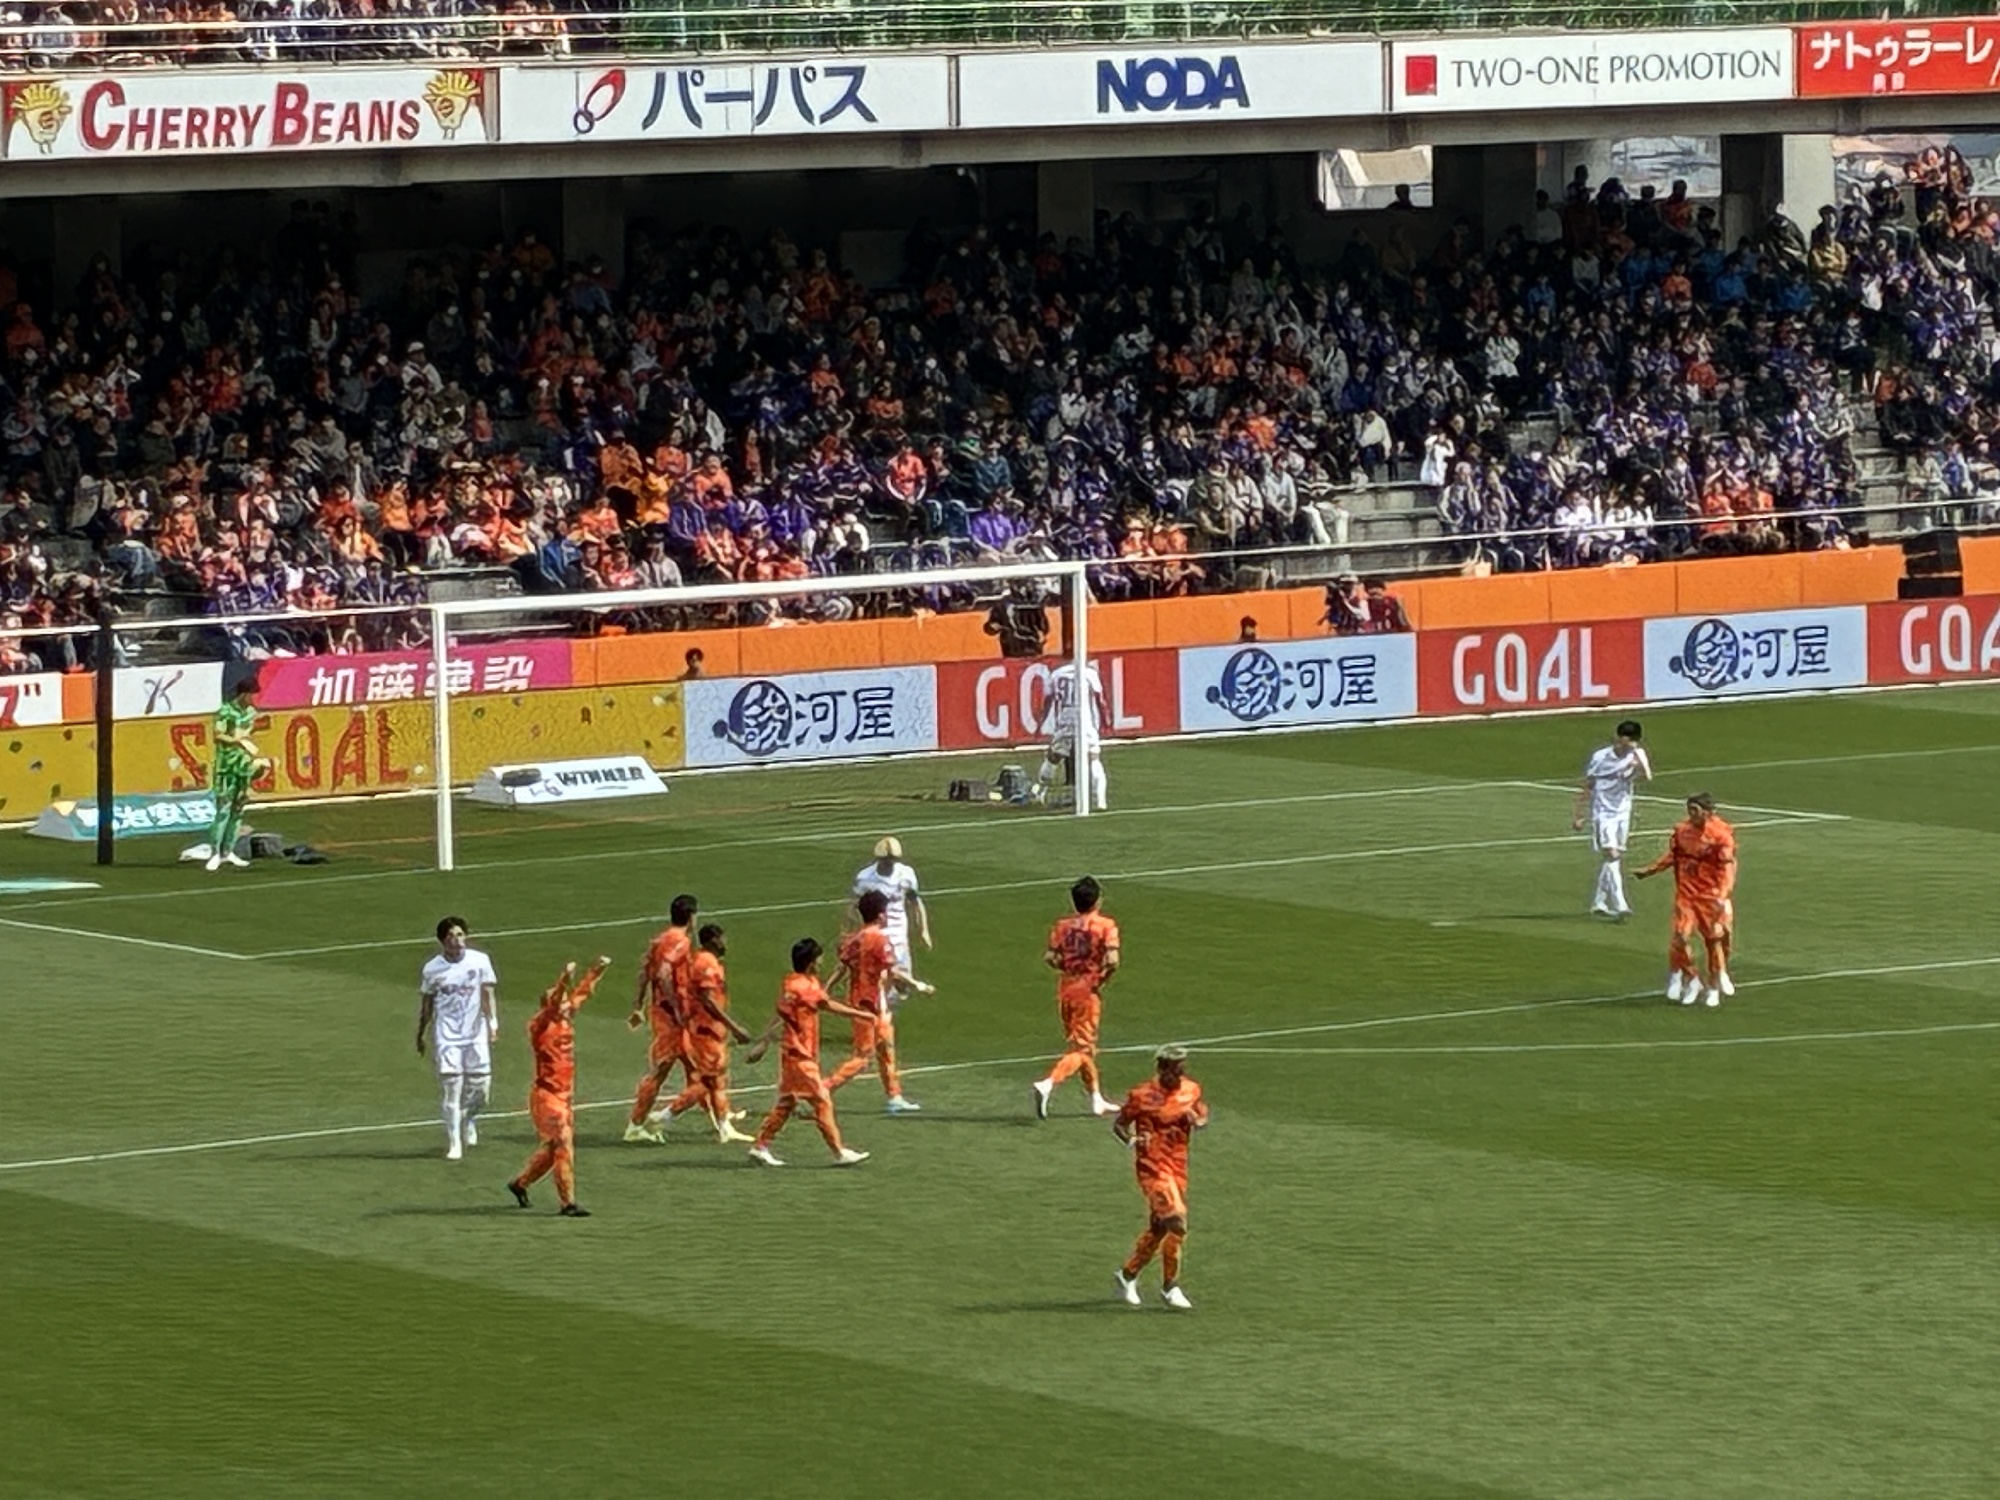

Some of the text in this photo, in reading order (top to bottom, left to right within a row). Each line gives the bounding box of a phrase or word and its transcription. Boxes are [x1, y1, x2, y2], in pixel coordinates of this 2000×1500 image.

[1451, 50, 1782, 88] TWO-ONE PROMOTION
[1810, 26, 1994, 70] ナトゥラーレ
[81, 80, 421, 152] CHERRY BEANS
[642, 65, 878, 131] パーパス
[1096, 56, 1250, 113] NODA
[975, 656, 1144, 739] GOL
[1452, 627, 1610, 706] GOAL
